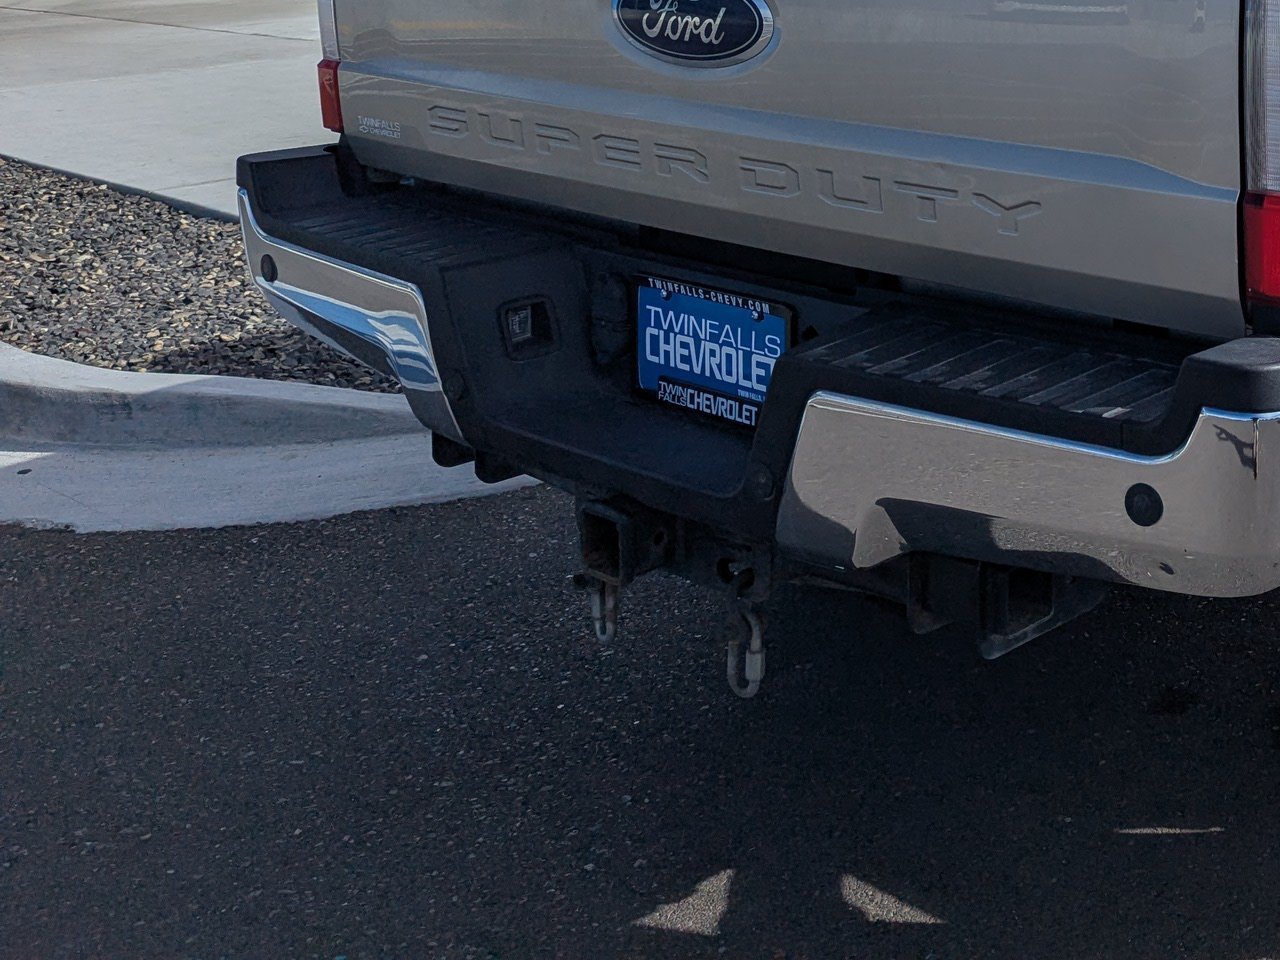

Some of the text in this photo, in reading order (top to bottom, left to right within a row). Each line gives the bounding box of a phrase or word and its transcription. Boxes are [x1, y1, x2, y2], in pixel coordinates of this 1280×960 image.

[358, 115, 401, 131] TWINFALLS
[427, 104, 1042, 236] SUPER DUTY
[648, 277, 771, 314] TWINFALLS-CHEVY.COM
[646, 304, 781, 358] TWINFALLS
[658, 380, 688, 398] TWIN
[658, 388, 758, 427] FALLS CHEVROLET
